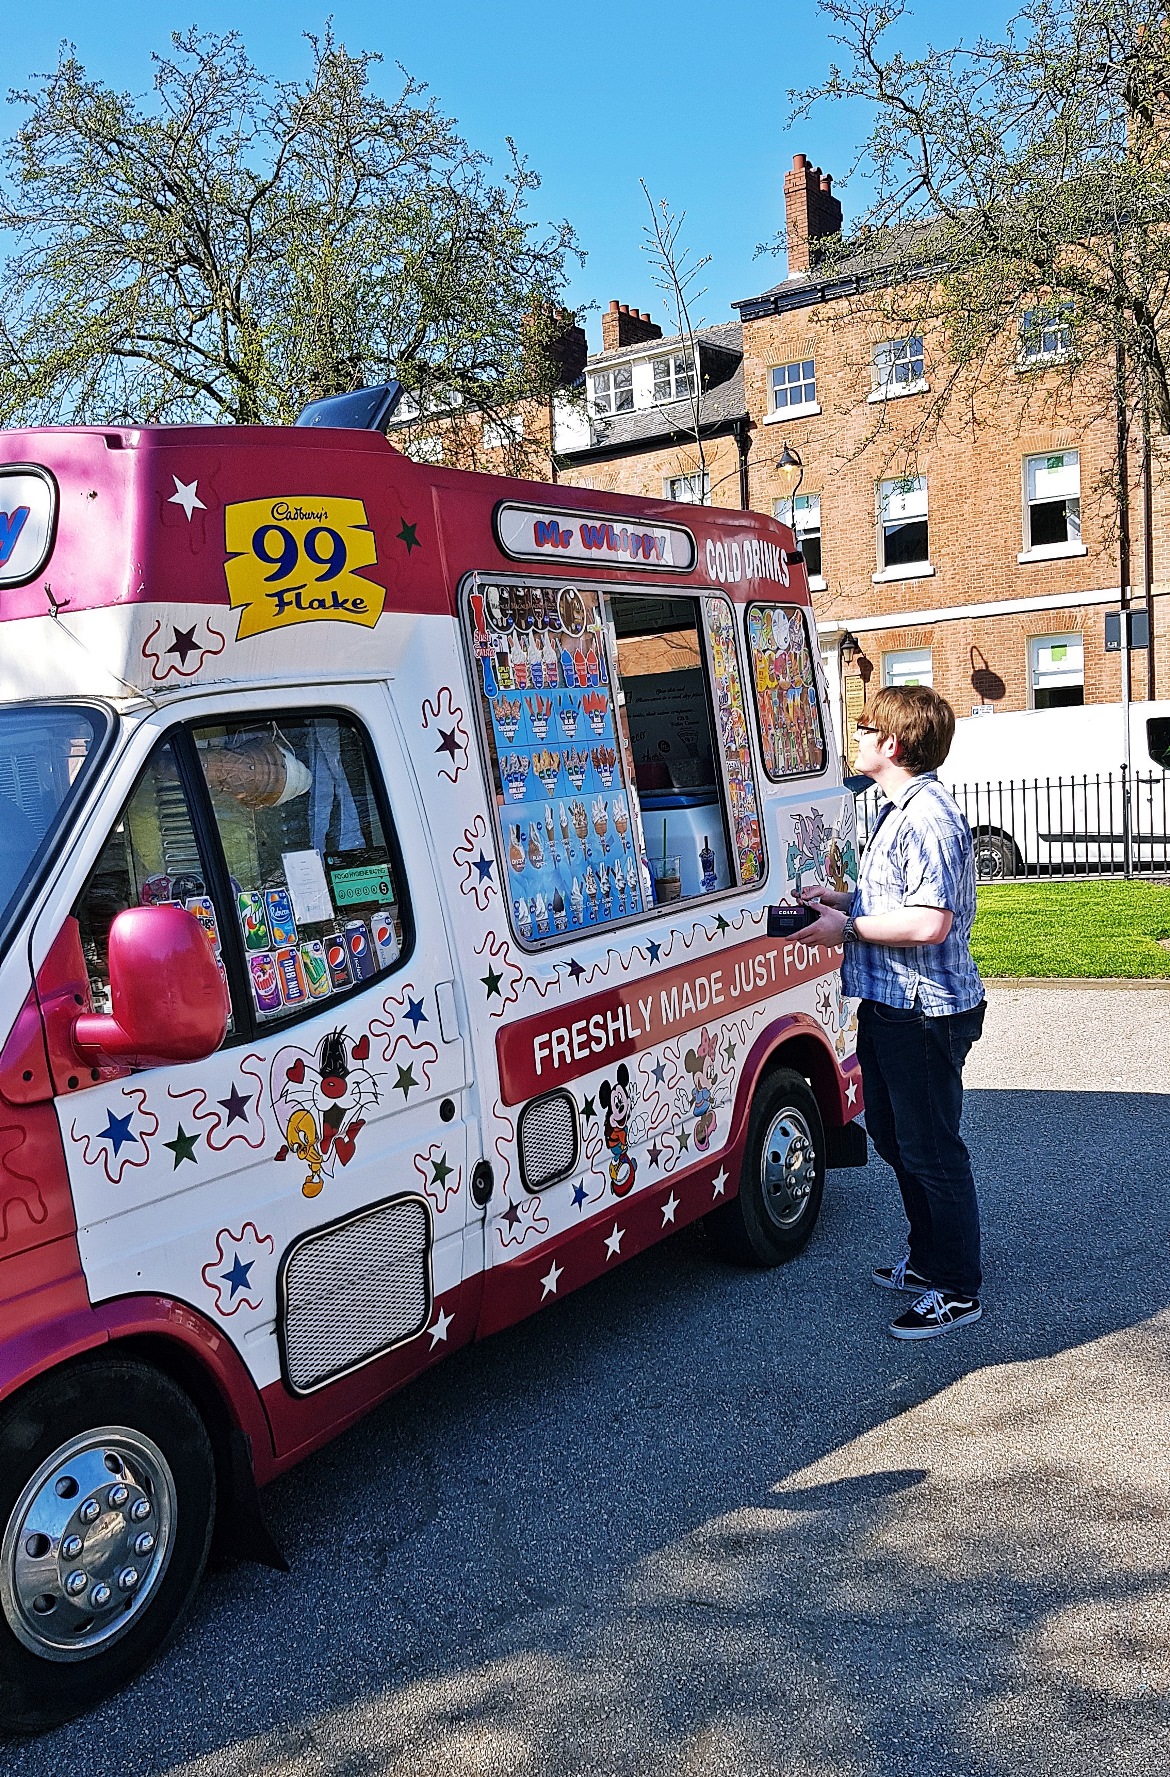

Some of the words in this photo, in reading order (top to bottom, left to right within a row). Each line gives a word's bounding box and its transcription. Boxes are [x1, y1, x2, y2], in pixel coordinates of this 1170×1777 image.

[271, 502, 329, 522] Cadbury's
[252, 524, 347, 582] 99
[534, 520, 573, 549] Mr
[580, 523, 666, 561] Whippy
[706, 538, 742, 584] COLD
[745, 539, 790, 588] DRINKS
[264, 583, 370, 617] Flake
[199, 917, 215, 930] ngo
[269, 906, 291, 917] Rubicon
[533, 995, 653, 1076] FRESHLY
[660, 970, 725, 1025] MADE
[729, 949, 777, 997] JUST
[783, 941, 820, 976] FOR
